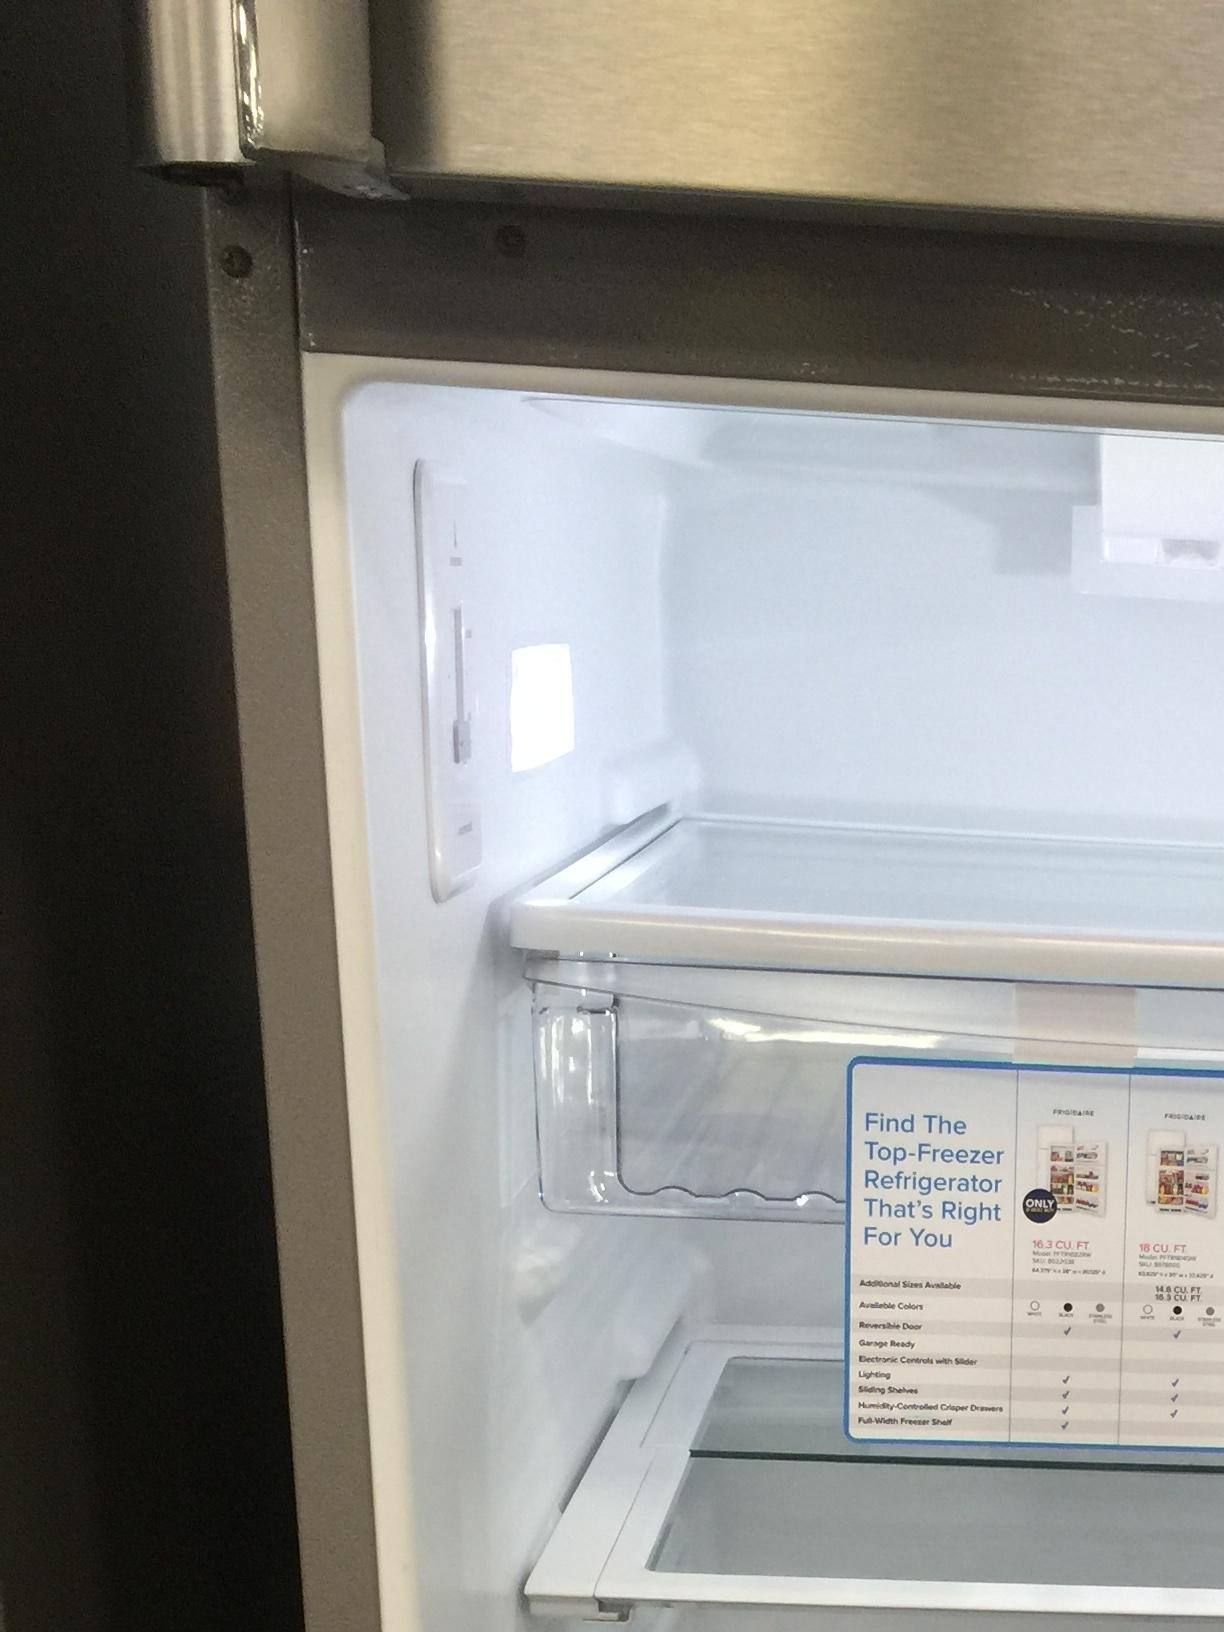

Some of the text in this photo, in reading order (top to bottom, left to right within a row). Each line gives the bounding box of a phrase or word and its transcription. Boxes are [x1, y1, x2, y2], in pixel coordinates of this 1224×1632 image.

[865, 1113, 967, 1135] Find The
[864, 1141, 1005, 1166] Top-Freezer
[864, 1170, 1003, 1196] Refrigerator
[1025, 1198, 1055, 1209] ONLY
[942, 1201, 1001, 1225] Right
[864, 1227, 953, 1248] For You
[1032, 1240, 1053, 1250] 16.3
[1138, 1244, 1151, 1253] 18
[859, 1280, 961, 1291] Additional Sizes Available
[859, 1301, 924, 1311] Available Colors
[859, 1321, 922, 1331] Reversible Door
[858, 1339, 915, 1350] Garage Ready
[858, 1355, 978, 1366] Electronic Controls with Slider
[858, 1371, 891, 1380] Lighting
[858, 1386, 919, 1395] Sliding Shelves
[858, 1401, 1004, 1413] Humidity-Controlled Crisper Drawers
[858, 1417, 953, 1427] Full-Width Freezer Shelf
